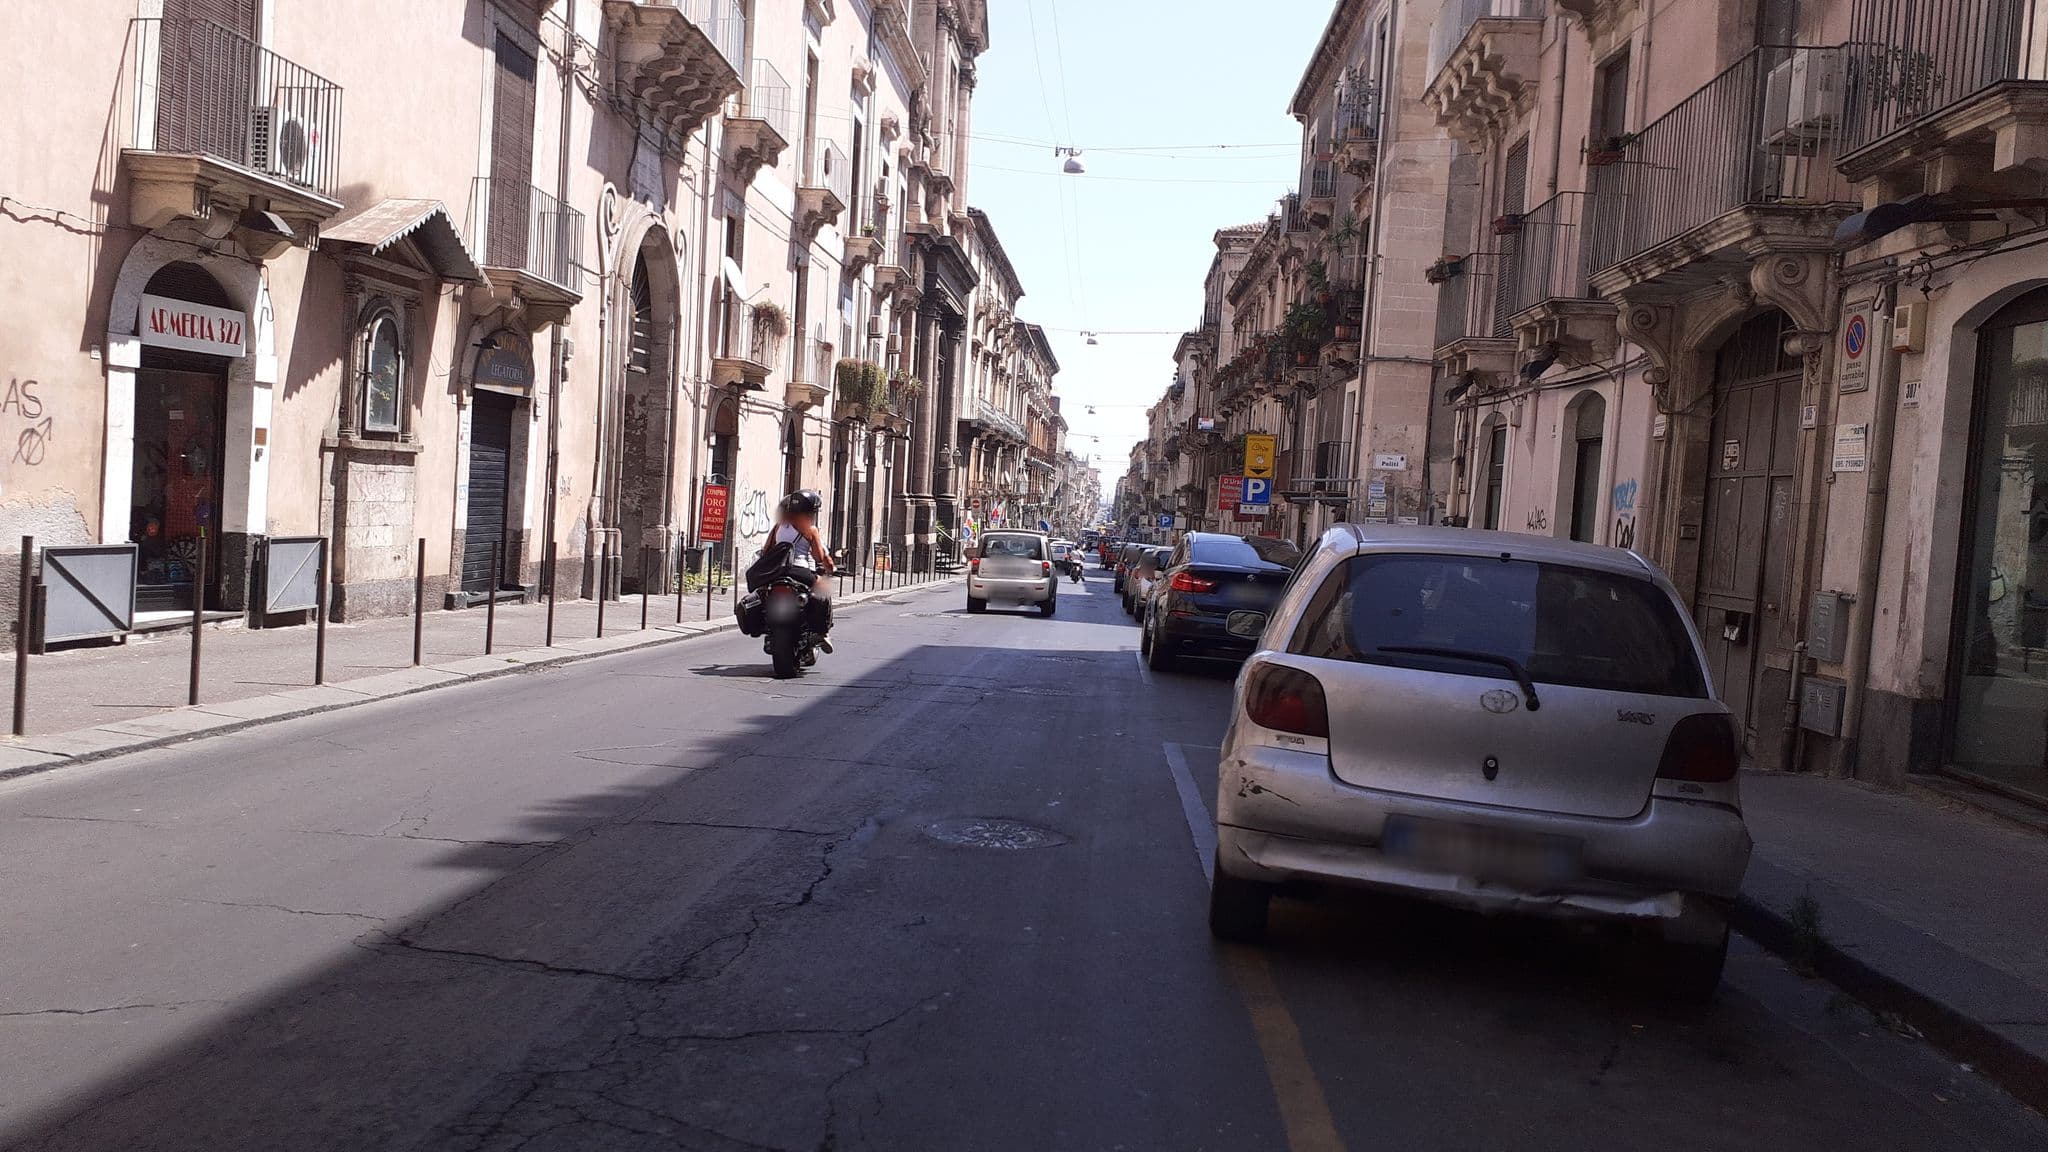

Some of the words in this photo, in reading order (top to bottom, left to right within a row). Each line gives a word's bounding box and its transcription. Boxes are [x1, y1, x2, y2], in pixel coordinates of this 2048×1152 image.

[149, 306, 215, 342] ARMERIA
[217, 317, 241, 345] 322
[490, 363, 523, 381] LEGATORIA
[706, 488, 726, 497] COMPRO
[1247, 479, 1266, 502] P
[705, 498, 726, 507] ORO
[1162, 516, 1170, 526] P
